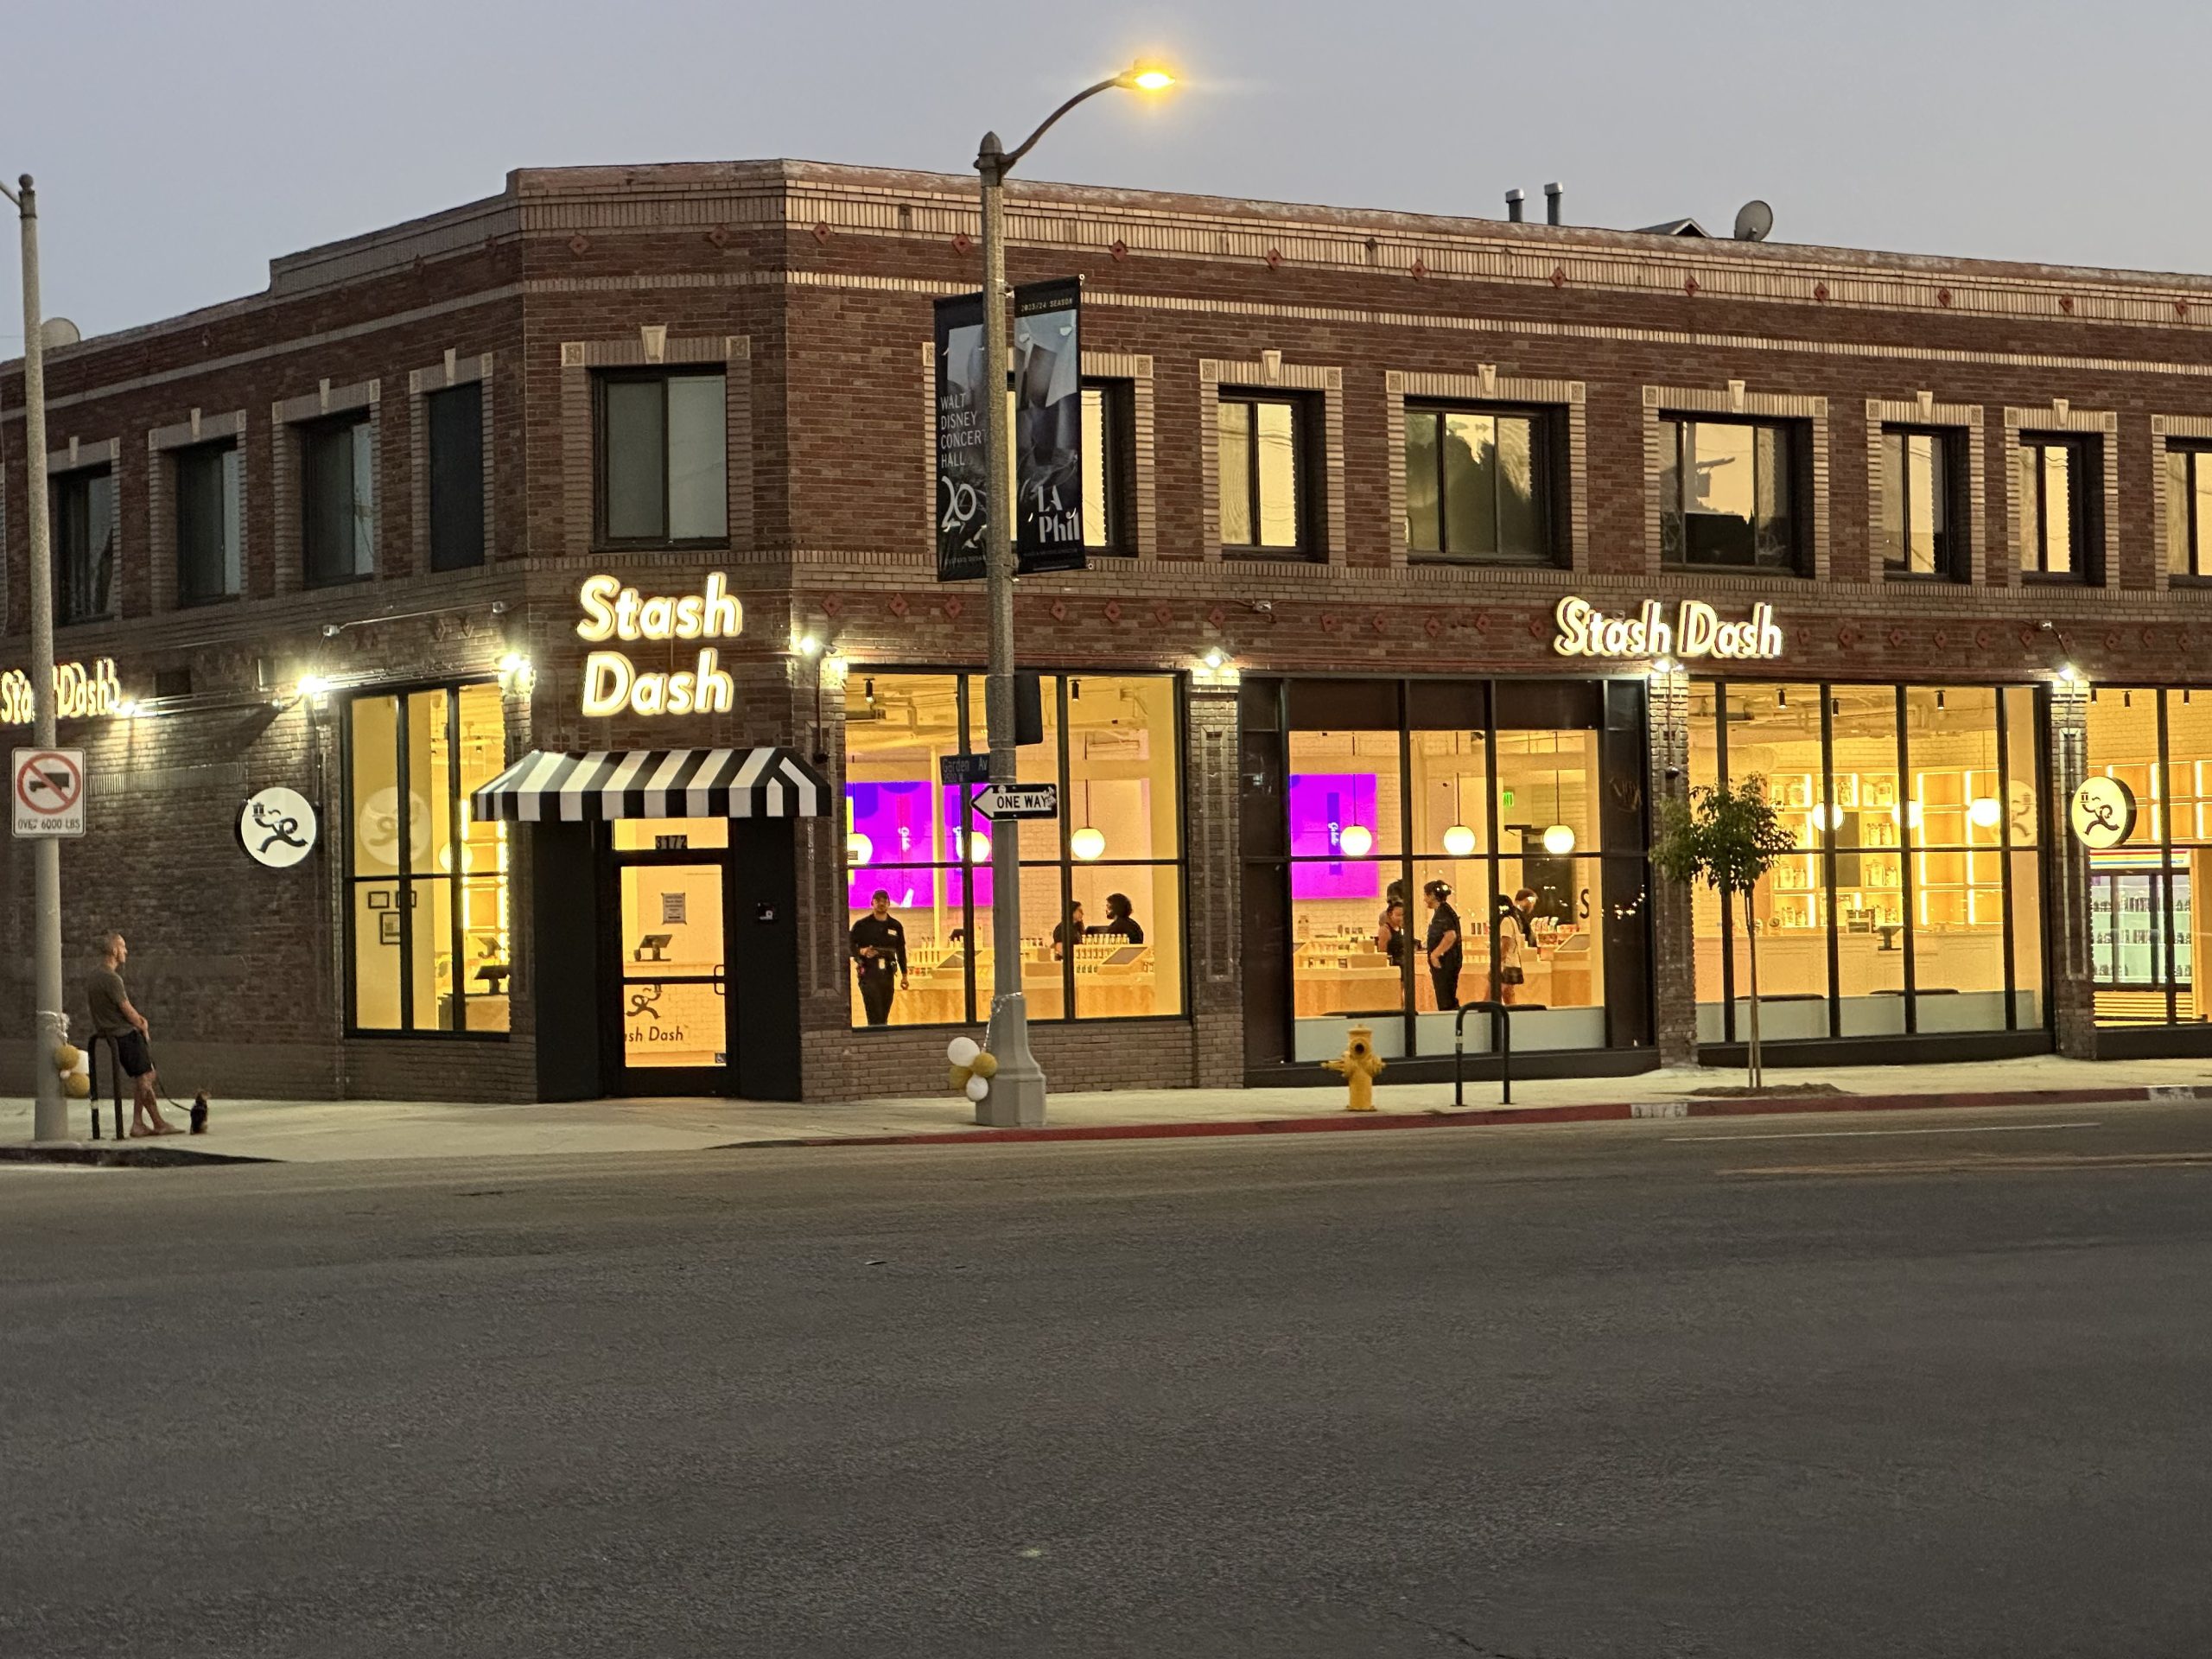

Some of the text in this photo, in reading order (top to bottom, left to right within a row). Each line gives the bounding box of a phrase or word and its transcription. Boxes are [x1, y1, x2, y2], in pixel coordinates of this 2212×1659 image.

[940, 392, 966, 410] WALT
[941, 410, 977, 430] DISNEY
[941, 451, 965, 468] HALL
[1038, 485, 1063, 513] LA
[1039, 509, 1080, 543] Phil
[576, 571, 743, 642] Stash
[1554, 596, 1783, 659] Stash Dash
[56, 658, 120, 719] Dash
[582, 647, 734, 717] Dash
[943, 757, 969, 773] Garden
[996, 795, 1020, 809] ONE
[1025, 795, 1047, 809] WAY
[41, 818, 62, 830] 6000
[65, 818, 80, 829] LBS
[648, 1026, 683, 1041] Dash
